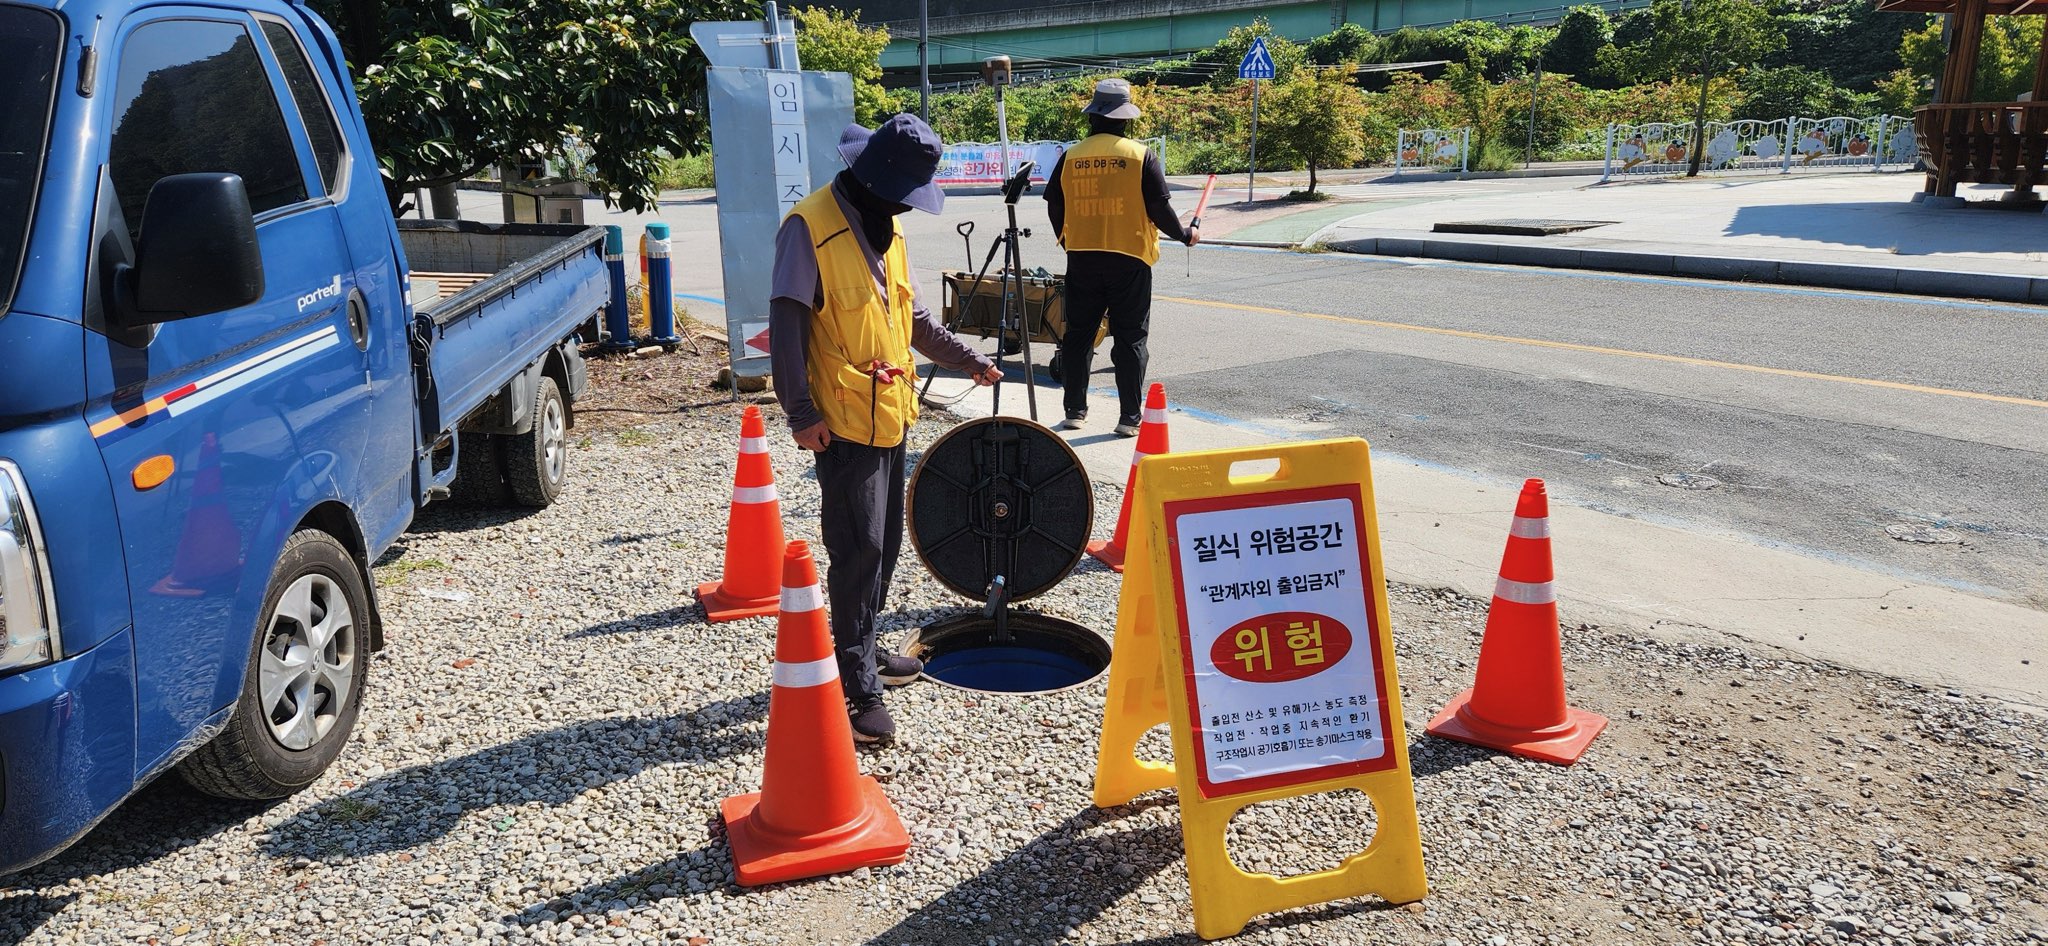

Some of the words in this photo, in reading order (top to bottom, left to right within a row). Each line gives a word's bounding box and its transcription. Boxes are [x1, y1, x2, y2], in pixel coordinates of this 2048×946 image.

[963, 161, 1004, 176] 한가위
[1074, 160, 1091, 169] GIS
[1094, 159, 1107, 168] DB
[1072, 177, 1099, 197] THE
[1193, 532, 1241, 563] 질식
[1250, 522, 1344, 556] 위험공간
[1211, 712, 1240, 727] 출입전
[1245, 709, 1264, 722] 산소
[1268, 707, 1277, 719] 및
[1282, 701, 1321, 717] 유해가스
[1325, 698, 1344, 711] 농도
[1349, 694, 1367, 706] 측정
[1213, 729, 1246, 744] 작업전
[1259, 722, 1291, 736] 작업중
[1299, 715, 1342, 731] 지속적인
[1349, 711, 1370, 724] 환기
[1215, 746, 1256, 762] 구조작업시
[1257, 739, 1297, 756] 공기호흡기
[1298, 738, 1315, 749] 또는
[1316, 731, 1355, 747] 송기마스크
[1356, 728, 1373, 740] 착용
